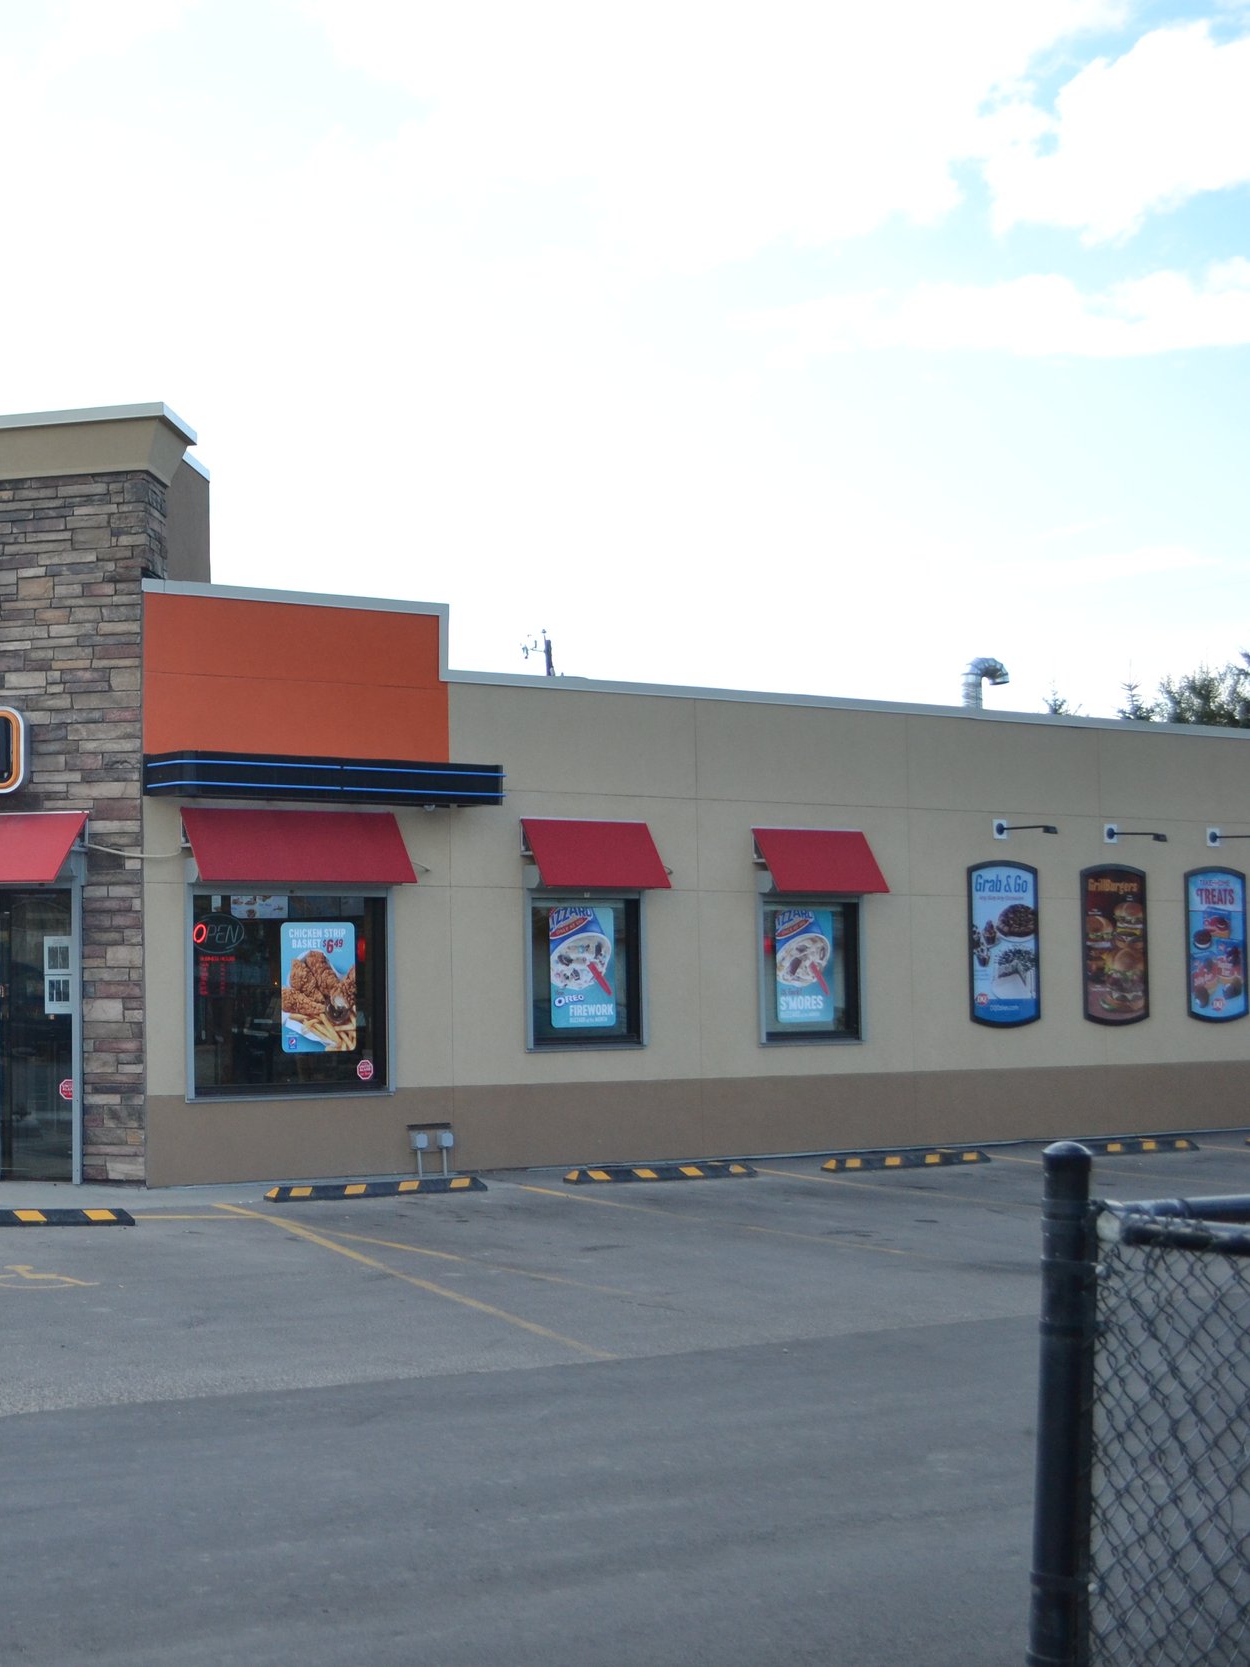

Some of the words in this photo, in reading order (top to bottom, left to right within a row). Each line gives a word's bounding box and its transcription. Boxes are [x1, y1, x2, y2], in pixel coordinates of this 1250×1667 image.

[975, 874, 1001, 893] Grab
[1004, 875, 1013, 893] &
[1014, 875, 1028, 893] Go
[1195, 888, 1235, 905] TREATS
[193, 923, 239, 943] OPEN
[288, 928, 322, 938] CHICKEN
[324, 928, 346, 938] STRIP
[291, 938, 321, 948] BASKET
[554, 994, 584, 1007] OREO
[780, 995, 824, 1010] S'MORES
[570, 1004, 613, 1016] FIREWORK
